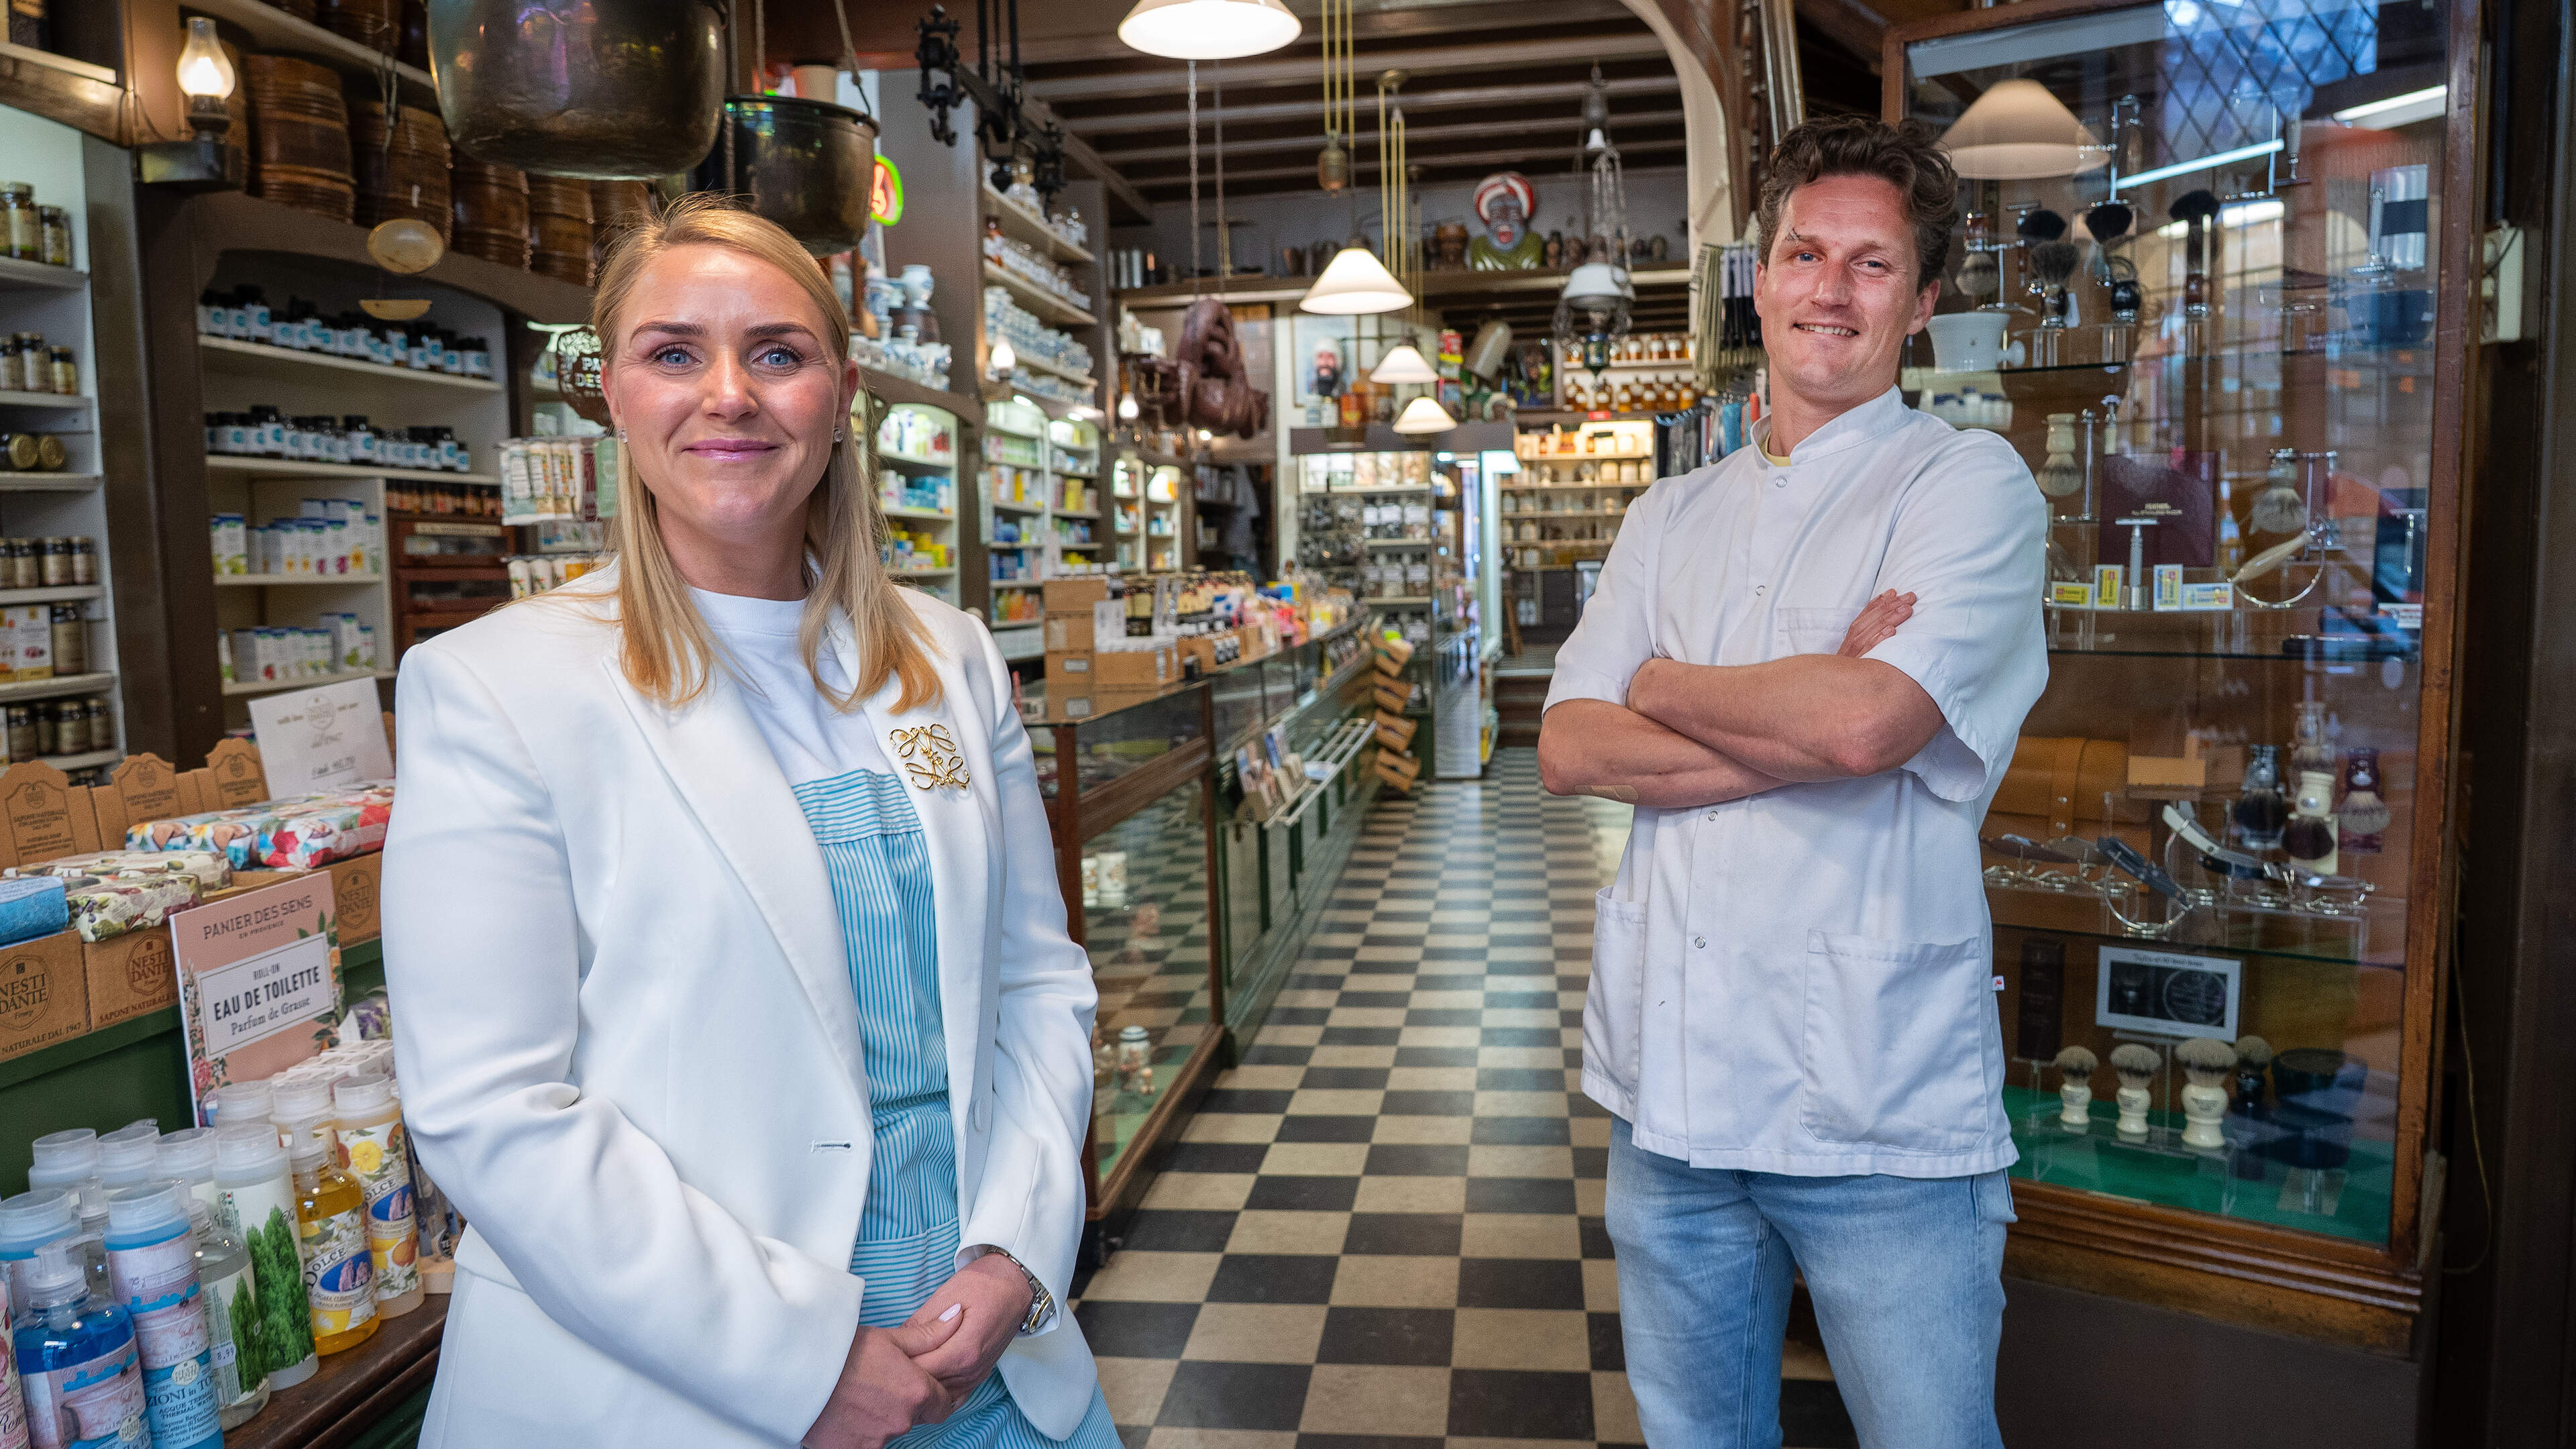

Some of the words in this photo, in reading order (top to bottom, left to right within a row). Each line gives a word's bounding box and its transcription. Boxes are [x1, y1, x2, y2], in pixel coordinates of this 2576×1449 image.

[203, 913, 253, 940] PANIER
[254, 906, 280, 924] DES
[282, 895, 313, 916] SENS
[130, 961, 171, 983] DANTE
[131, 950, 168, 970] NESTI
[253, 963, 280, 981] ROLL-ON
[213, 995, 241, 1021] EAU
[245, 987, 261, 1010] DE
[264, 966, 320, 1001] TOILETTE
[99, 1006, 130, 1023] SAPONE
[231, 1014, 266, 1036] Parfum
[268, 1007, 280, 1020] de
[281, 997, 312, 1015] Grasse
[1, 1034, 46, 1054] NATURALE
[47, 1028, 63, 1040] DAL
[65, 1022, 83, 1034] 1947
